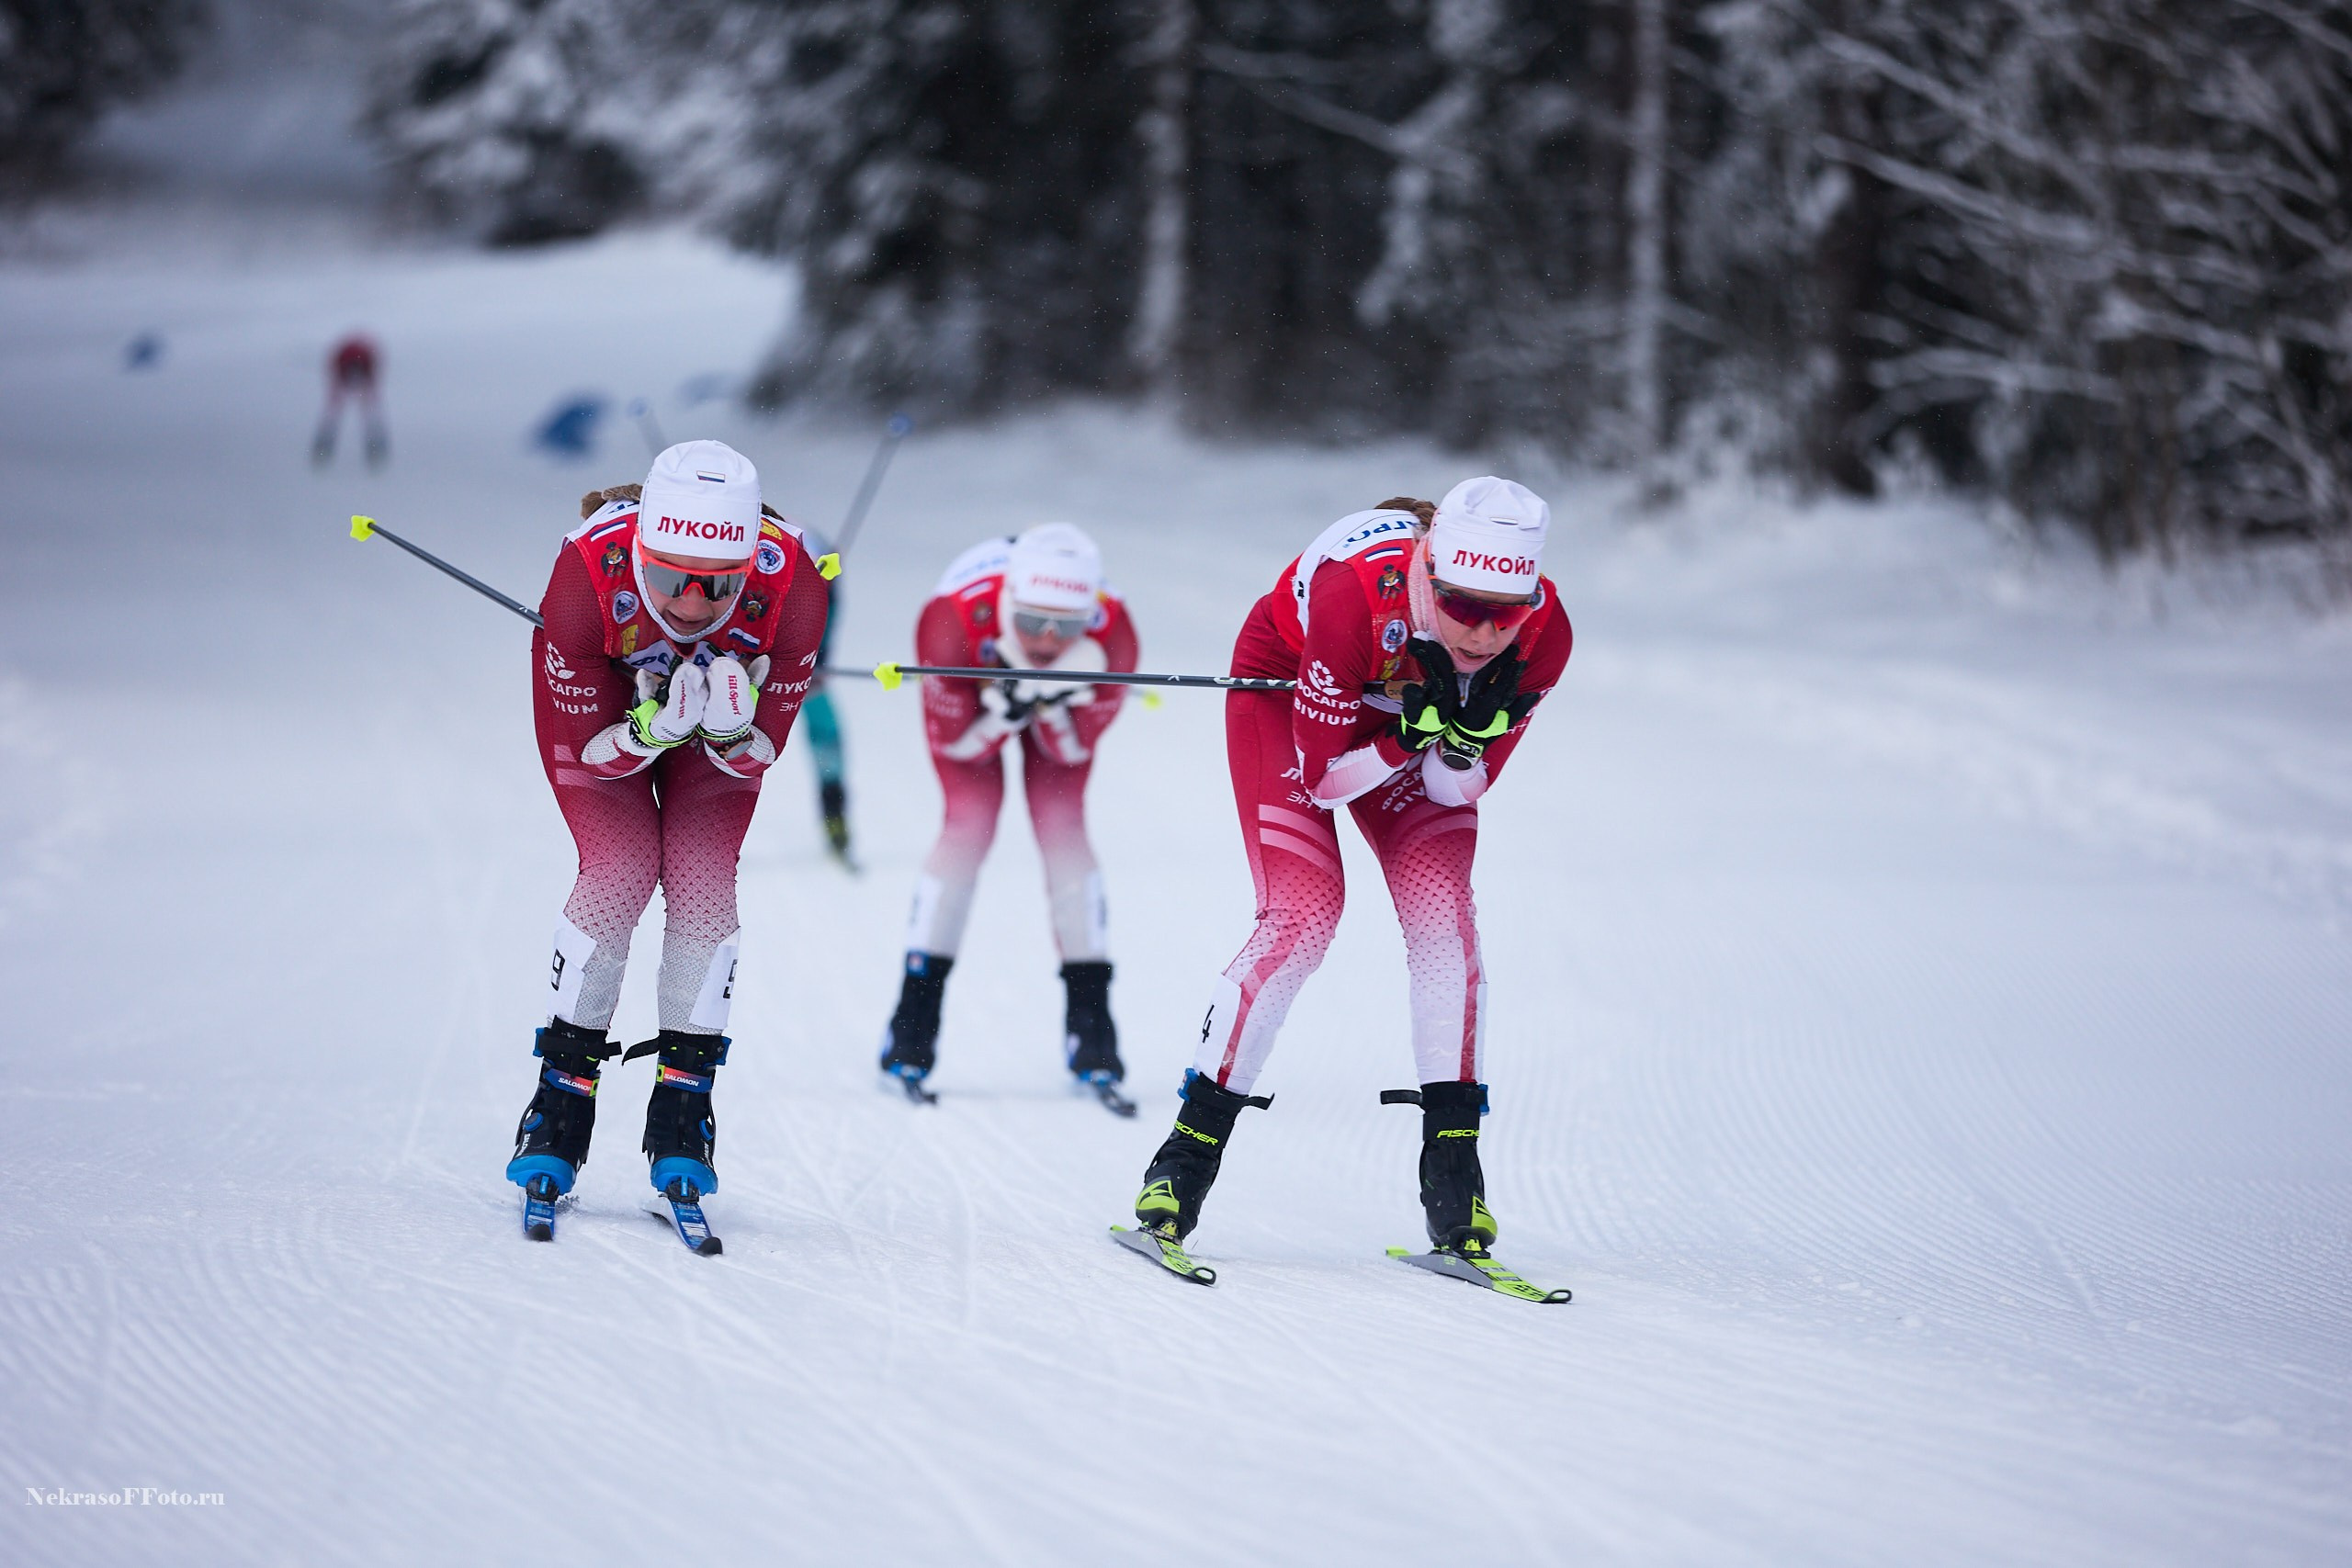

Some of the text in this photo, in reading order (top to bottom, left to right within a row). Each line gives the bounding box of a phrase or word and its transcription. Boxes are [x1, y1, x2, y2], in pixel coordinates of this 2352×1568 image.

[657, 516, 744, 542] ЛУКОЙЛ
[1453, 549, 1535, 576] ЛУКОЙЛ
[767, 676, 812, 694] ЛУКО
[552, 696, 599, 715] VIUM
[1294, 696, 1357, 726] BIVIUM
[1382, 772, 1422, 810] ФОСА
[1393, 786, 1425, 813] BIV
[551, 948, 566, 992] 9
[1202, 1004, 1215, 1043] 4
[663, 1073, 699, 1088] SALOMON
[1175, 1121, 1218, 1145] SCHER
